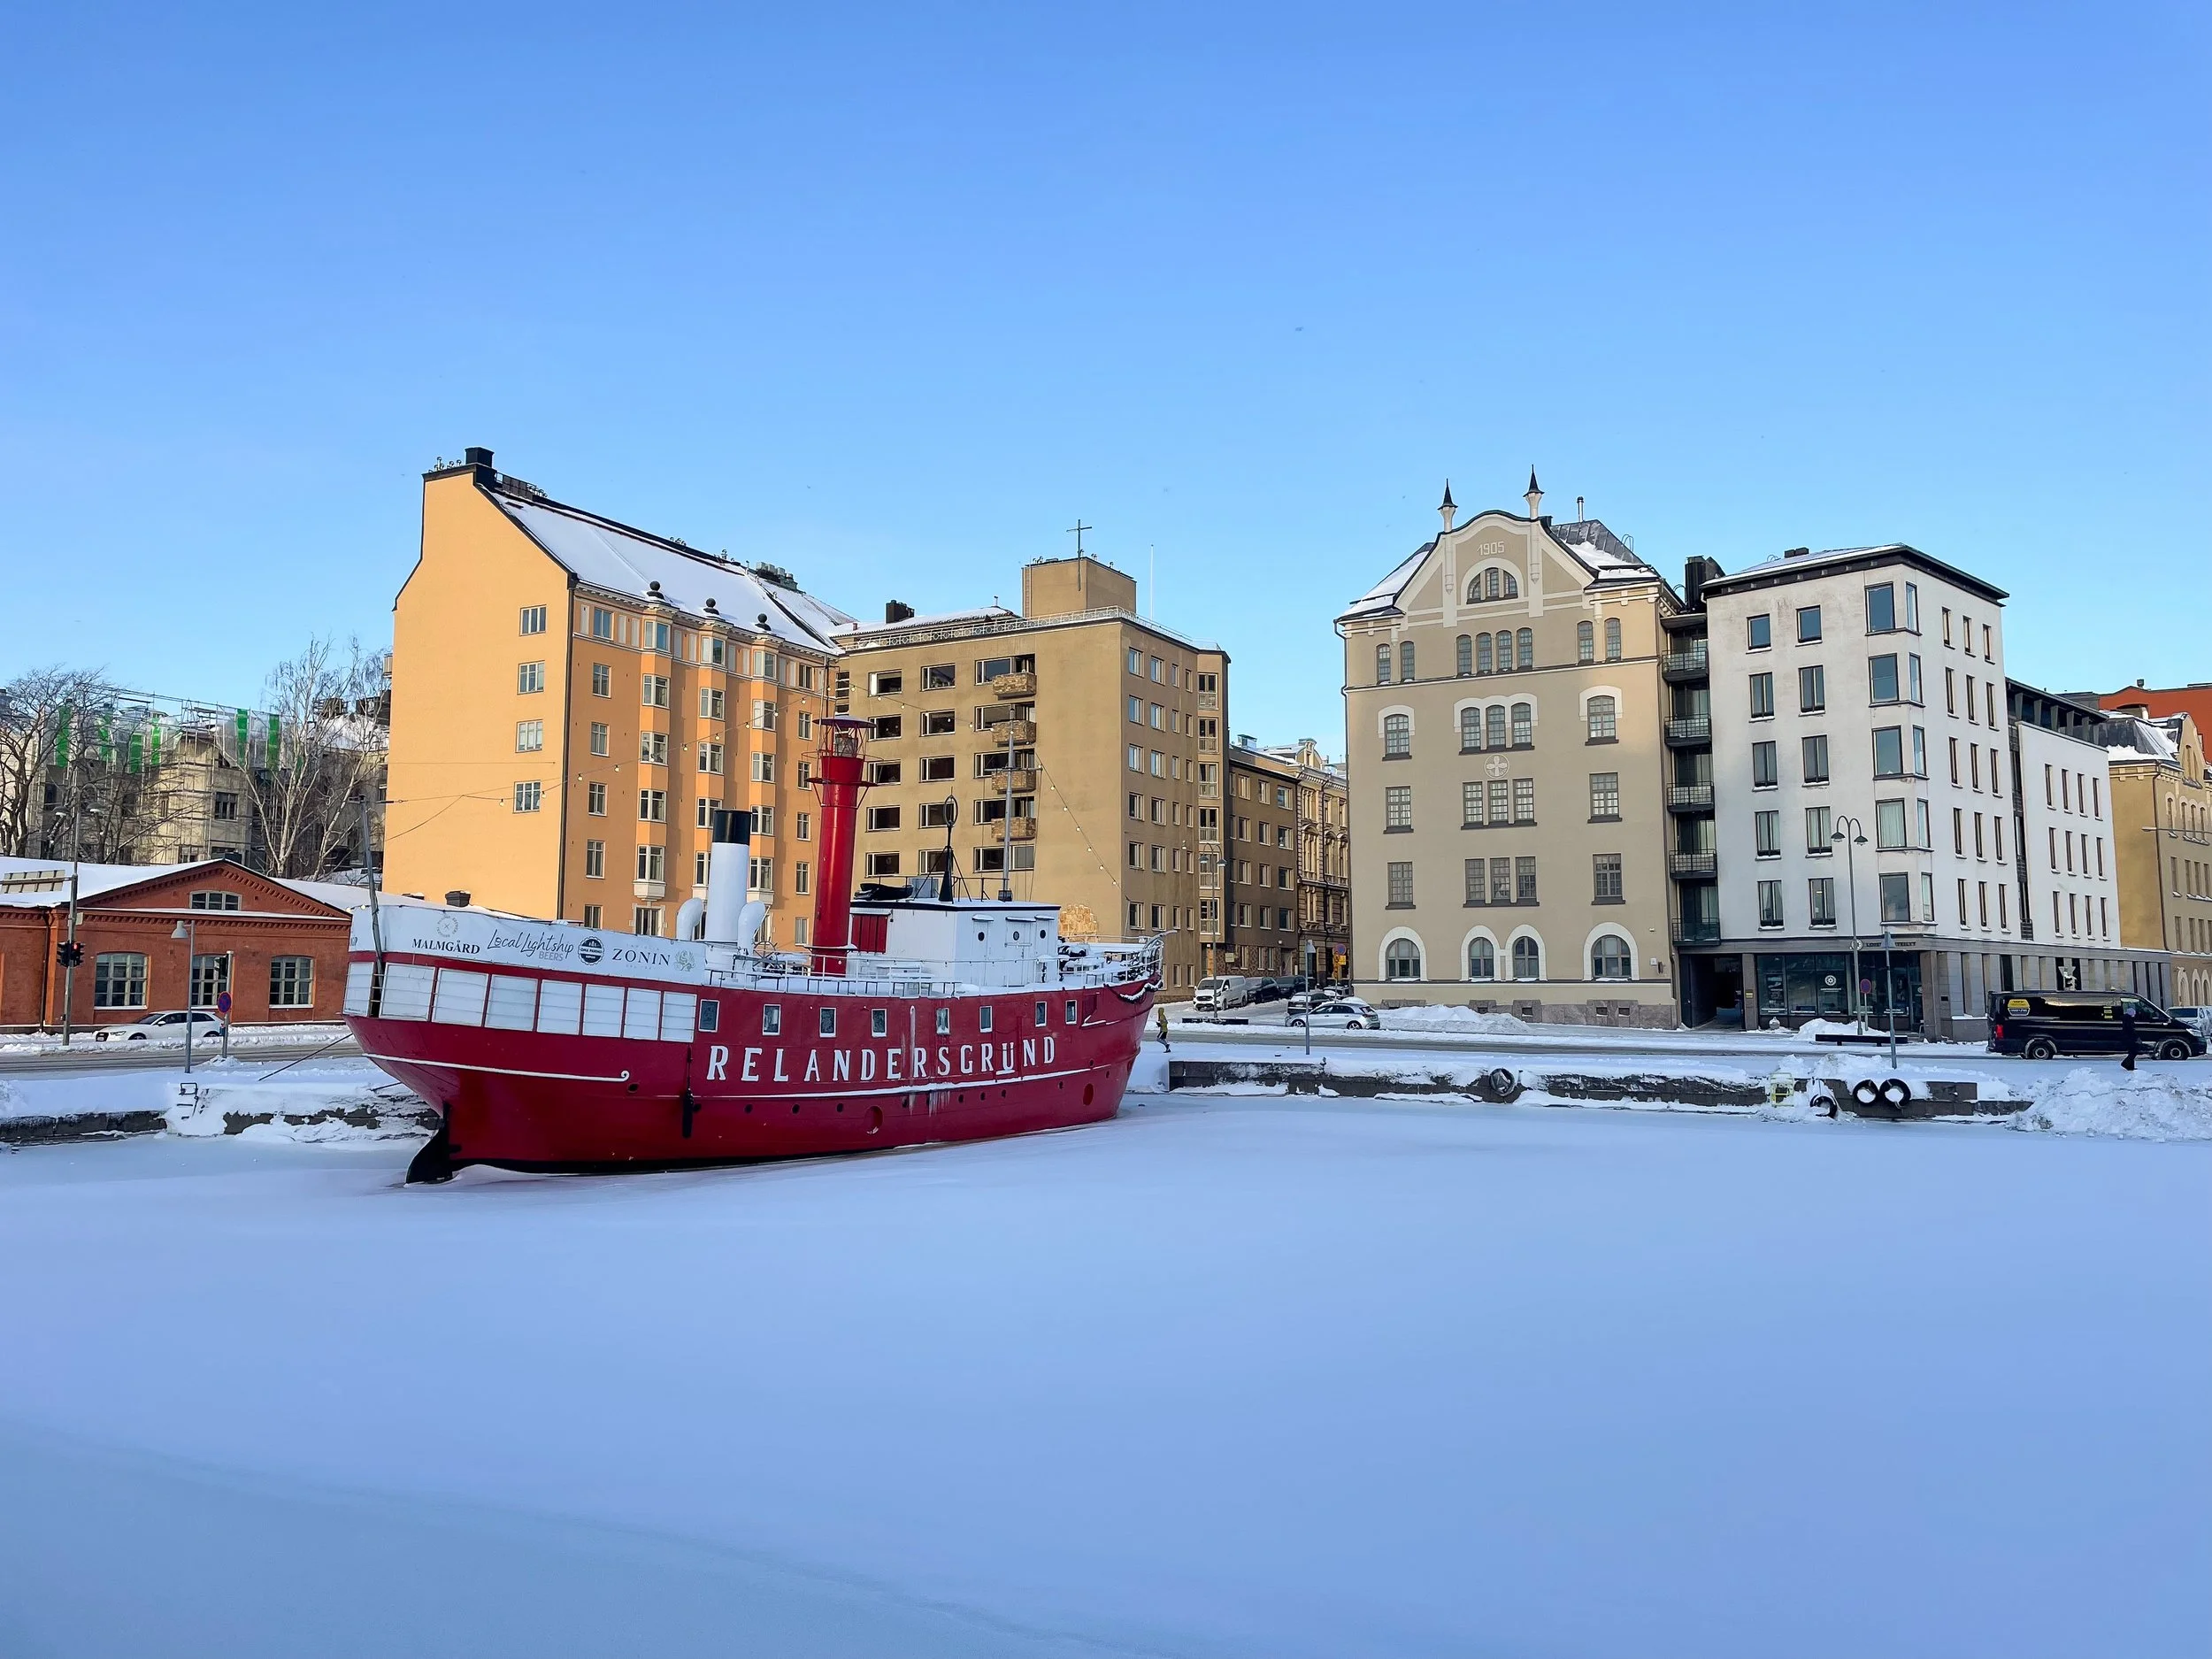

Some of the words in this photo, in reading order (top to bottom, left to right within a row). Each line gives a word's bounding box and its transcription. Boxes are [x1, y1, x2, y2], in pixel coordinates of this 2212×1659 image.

[1476, 541, 1504, 556] 1905
[412, 939, 480, 954] MALMGÅRD
[488, 929, 524, 949] Local
[520, 932, 574, 959] Lightship
[538, 950, 564, 961] BEERS
[612, 949, 671, 966] ZONIN
[707, 1036, 1056, 1081] RELANDERSGRUND
